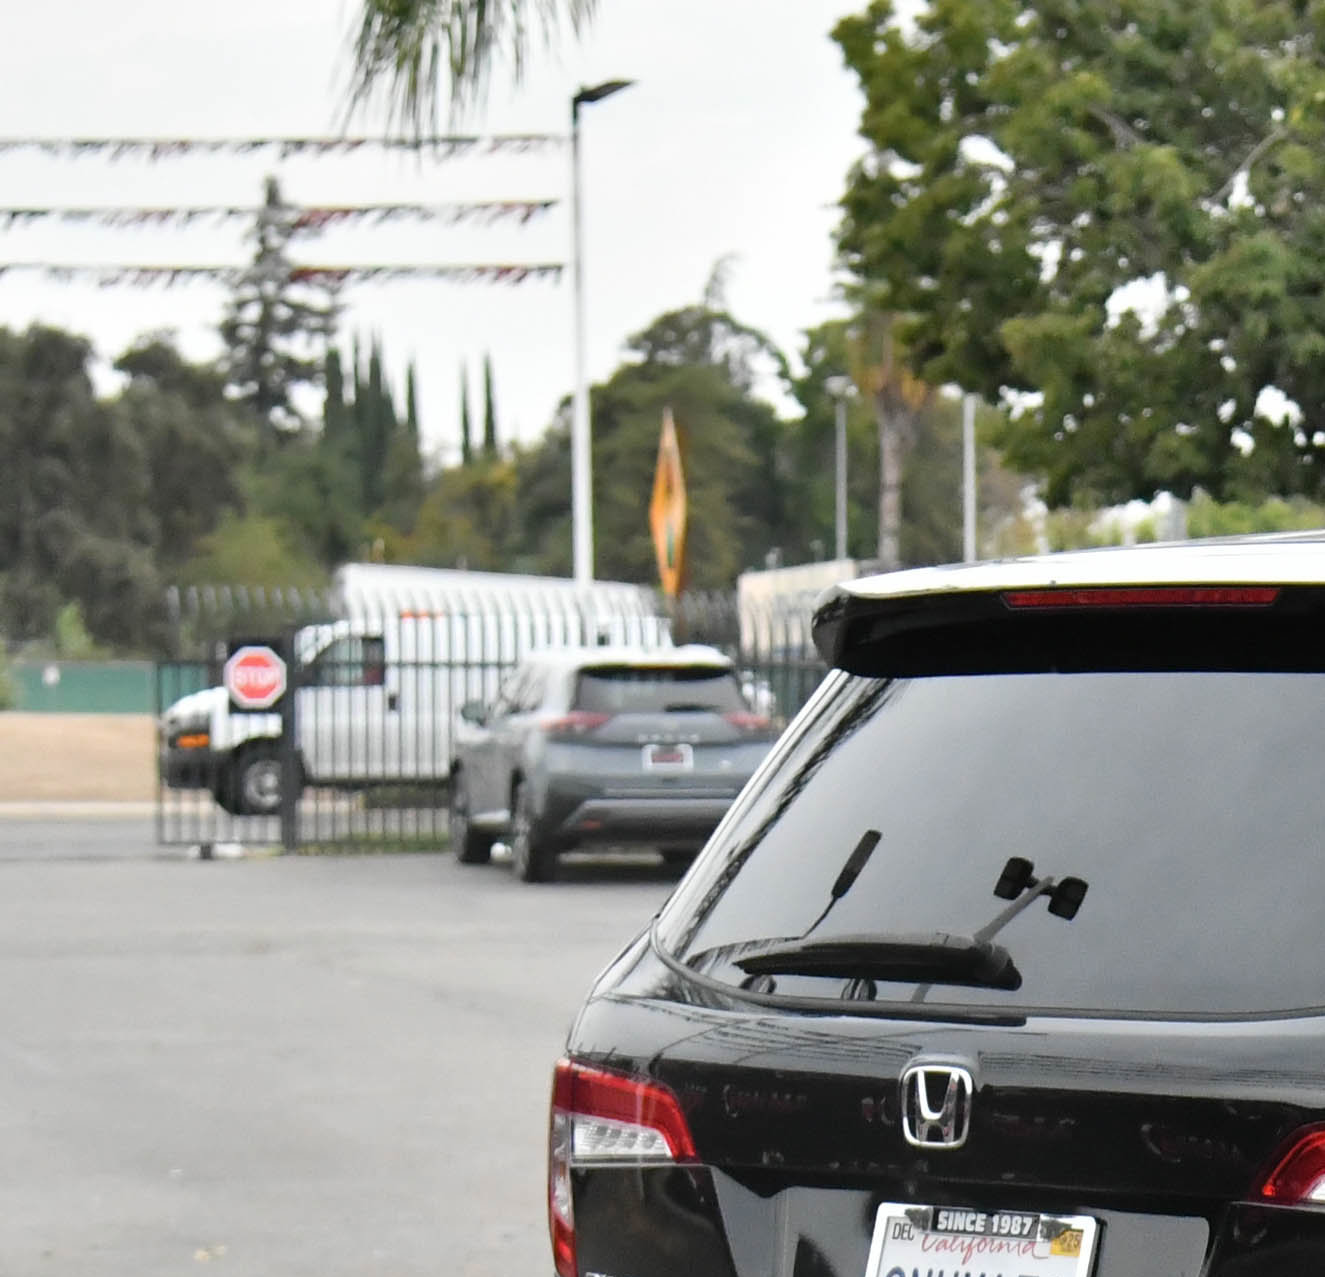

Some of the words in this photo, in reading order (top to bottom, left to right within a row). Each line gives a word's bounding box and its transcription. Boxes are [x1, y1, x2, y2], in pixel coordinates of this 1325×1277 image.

[234, 664, 281, 689] STOP
[937, 1210, 986, 1233] SINCE
[991, 1214, 1033, 1235] 1987
[921, 1232, 1049, 1265] California
